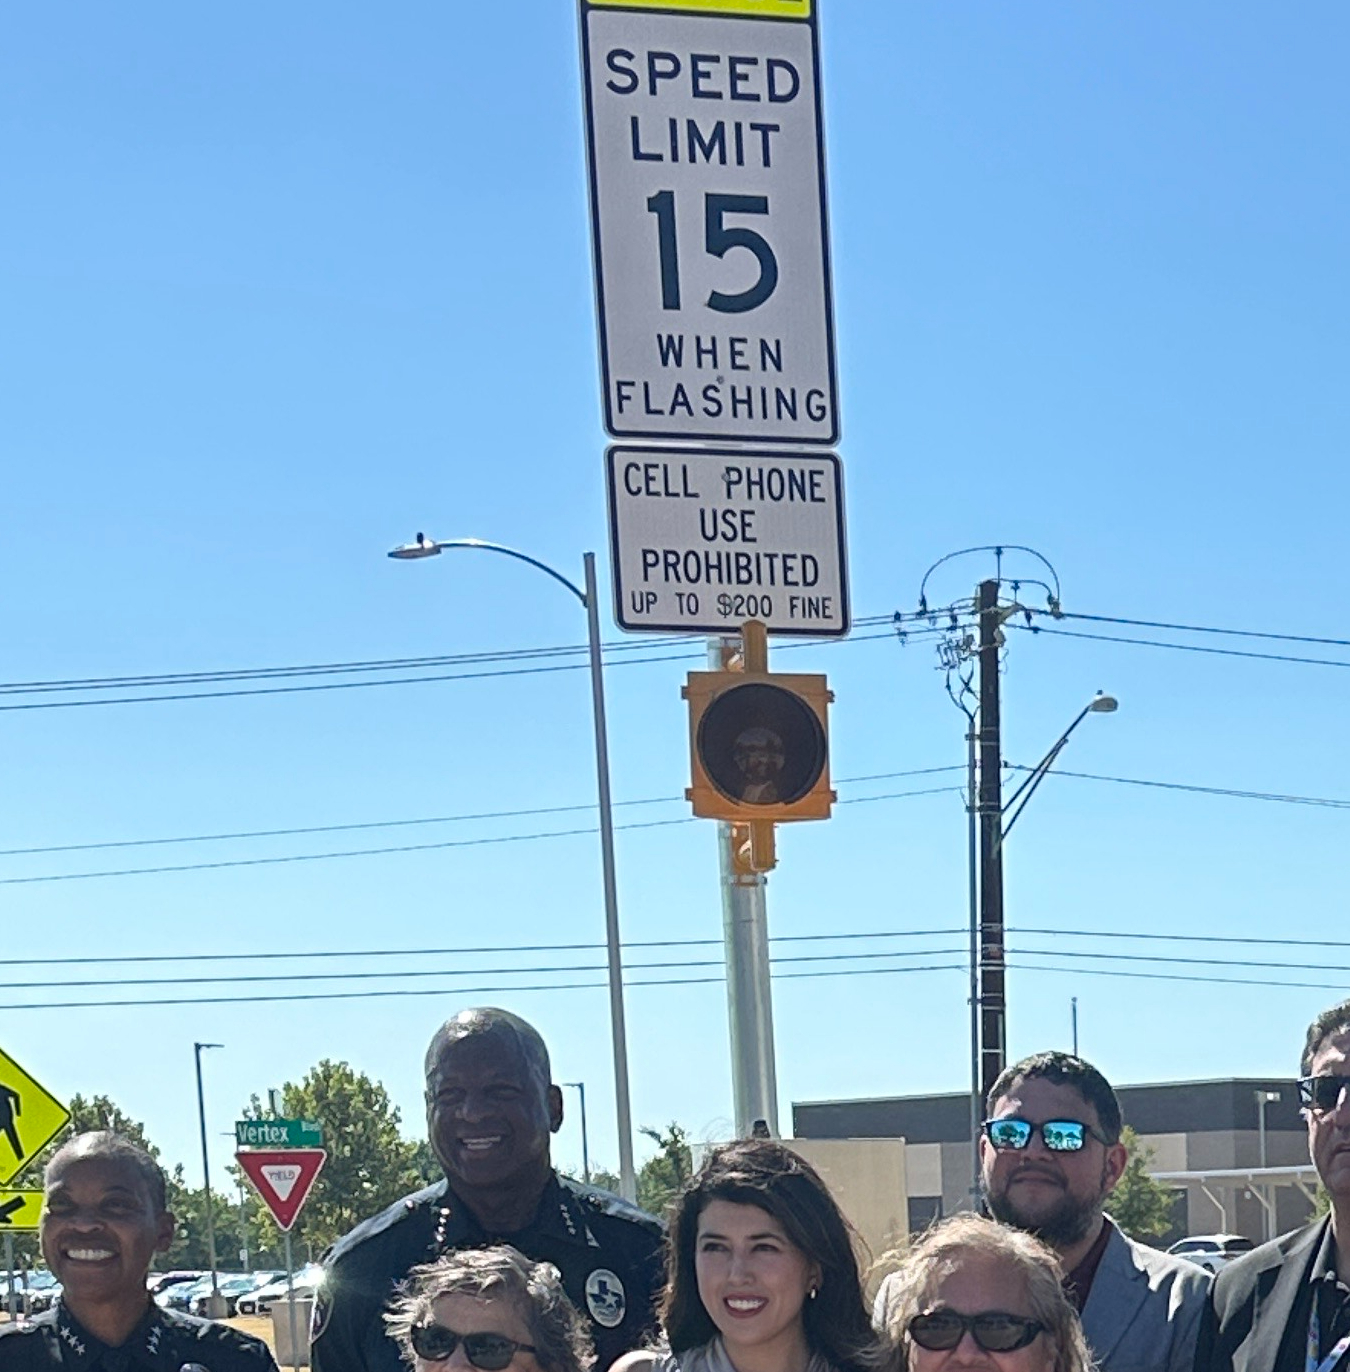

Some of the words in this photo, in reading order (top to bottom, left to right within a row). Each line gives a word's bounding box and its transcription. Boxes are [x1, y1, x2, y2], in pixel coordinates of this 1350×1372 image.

[605, 48, 800, 103] SPEED
[630, 115, 781, 168] LIMIT
[646, 189, 779, 315] 15
[656, 333, 783, 373] WHEN
[616, 380, 827, 423] FLASHING
[624, 461, 700, 498] CELL
[724, 466, 826, 503] PHONE
[700, 507, 757, 543] USE
[641, 548, 819, 587] PROHIBITED
[631, 590, 658, 615] UP
[675, 592, 699, 616] TO
[716, 592, 773, 619] $200
[789, 596, 834, 620] FINE
[237, 1123, 290, 1143] Vertex
